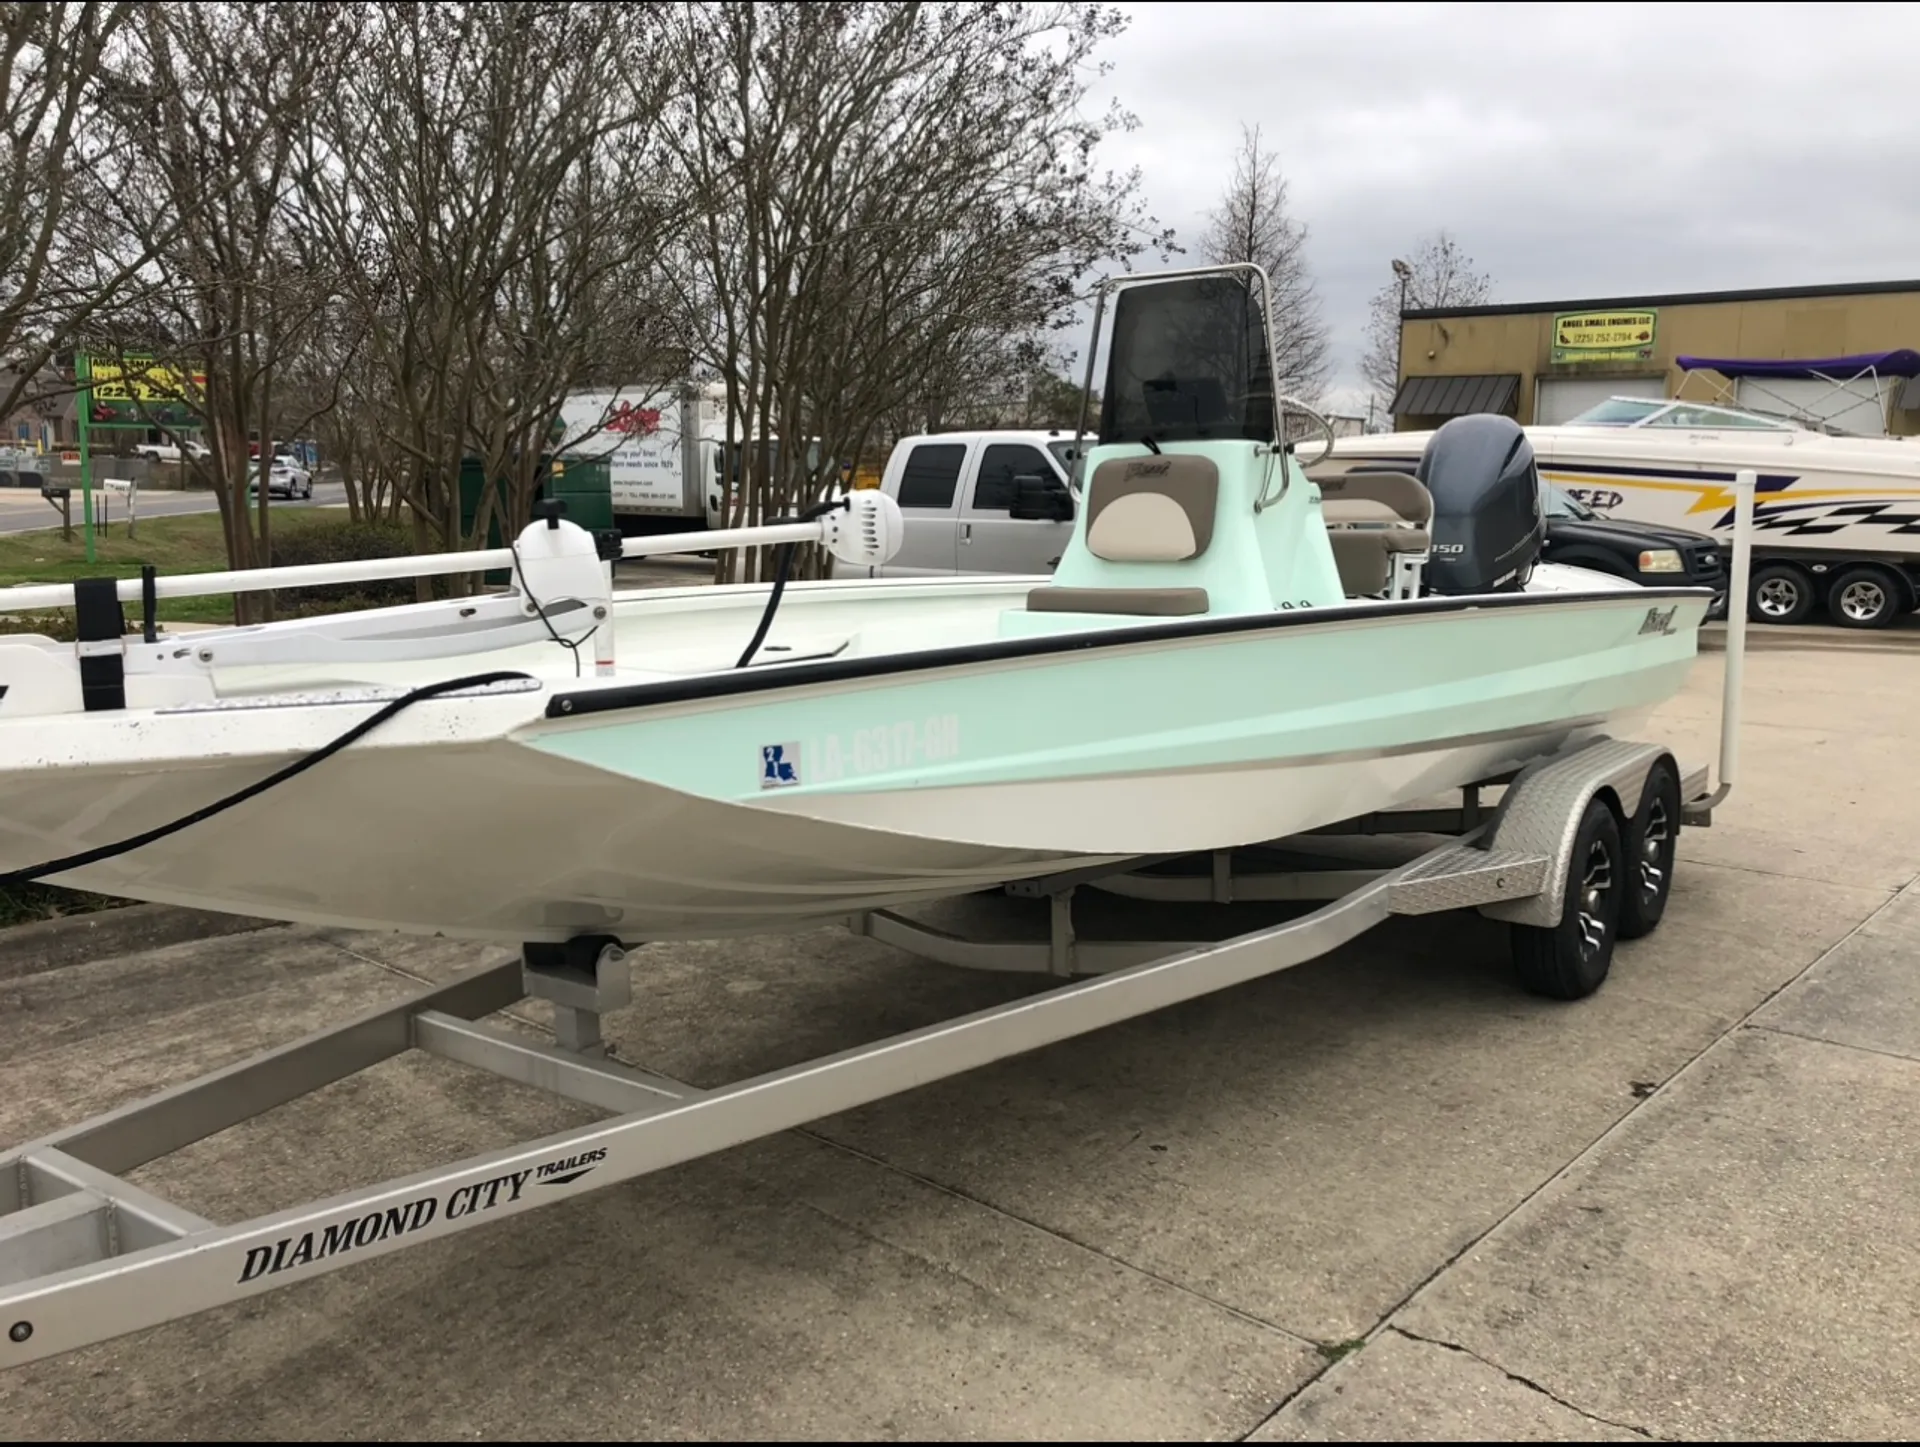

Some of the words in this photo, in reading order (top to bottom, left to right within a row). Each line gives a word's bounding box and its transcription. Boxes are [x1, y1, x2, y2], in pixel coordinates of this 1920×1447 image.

[1584, 318, 1606, 327] SMALL
[1567, 488, 1624, 510] PEED
[237, 1197, 438, 1284] DIAMOND
[445, 1168, 533, 1220] CITY
[535, 1146, 609, 1179] TRAILERS
